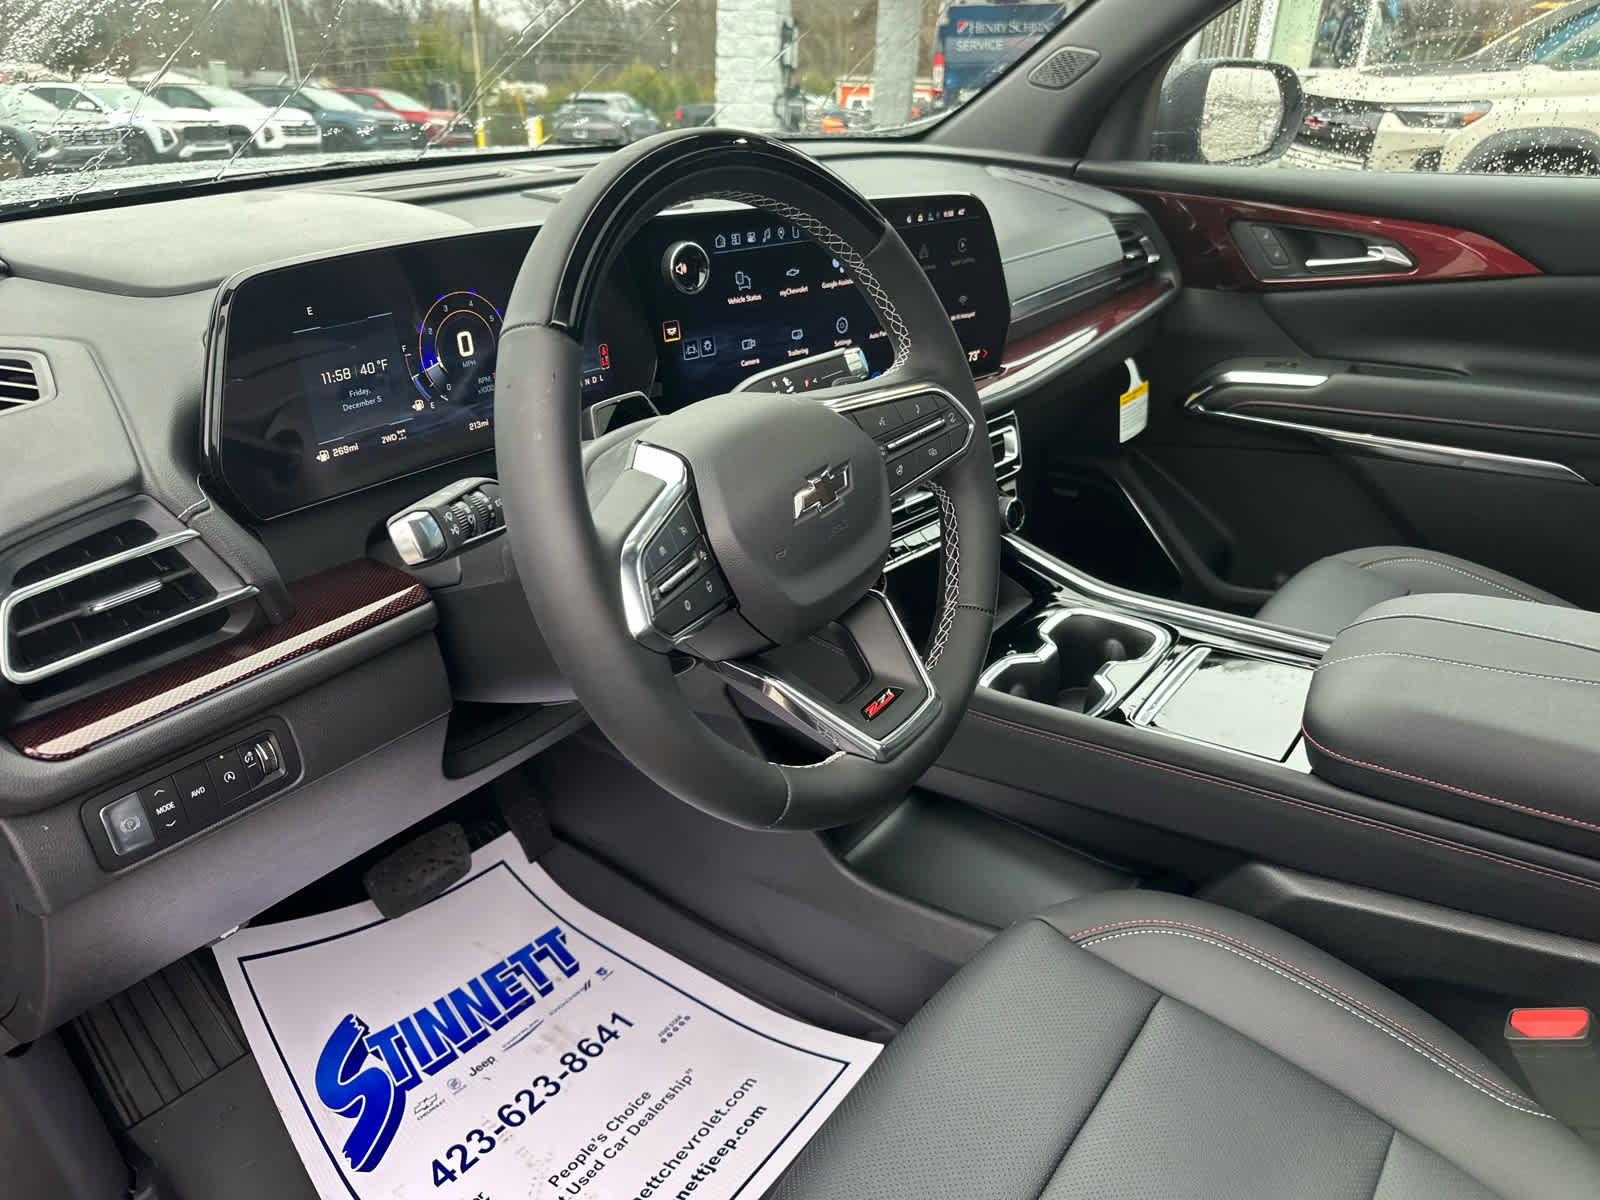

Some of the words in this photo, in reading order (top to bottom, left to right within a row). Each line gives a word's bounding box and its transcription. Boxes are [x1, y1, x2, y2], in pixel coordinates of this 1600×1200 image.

[956, 40, 1003, 51] SERVICE
[728, 296, 745, 305] Vehicle
[746, 294, 762, 302] Status
[306, 306, 313, 316] E
[456, 331, 474, 357] 0
[462, 360, 477, 368] MPH
[320, 368, 352, 385] 11:58
[342, 398, 377, 412] December
[381, 433, 398, 444] 2WD
[332, 443, 359, 458] 269mi
[191, 786, 206, 798] AWD
[156, 801, 176, 816] MODE
[315, 926, 580, 1172] STINNETT
[469, 1055, 496, 1077] Jeep
[431, 1011, 634, 1188] 423-623-8641
[548, 1134, 608, 1188] People's
[606, 1090, 652, 1133] Choice
[632, 1077, 758, 1200] ettchevrolet.com
[565, 1159, 606, 1196] Used
[603, 1136, 629, 1160] Car
